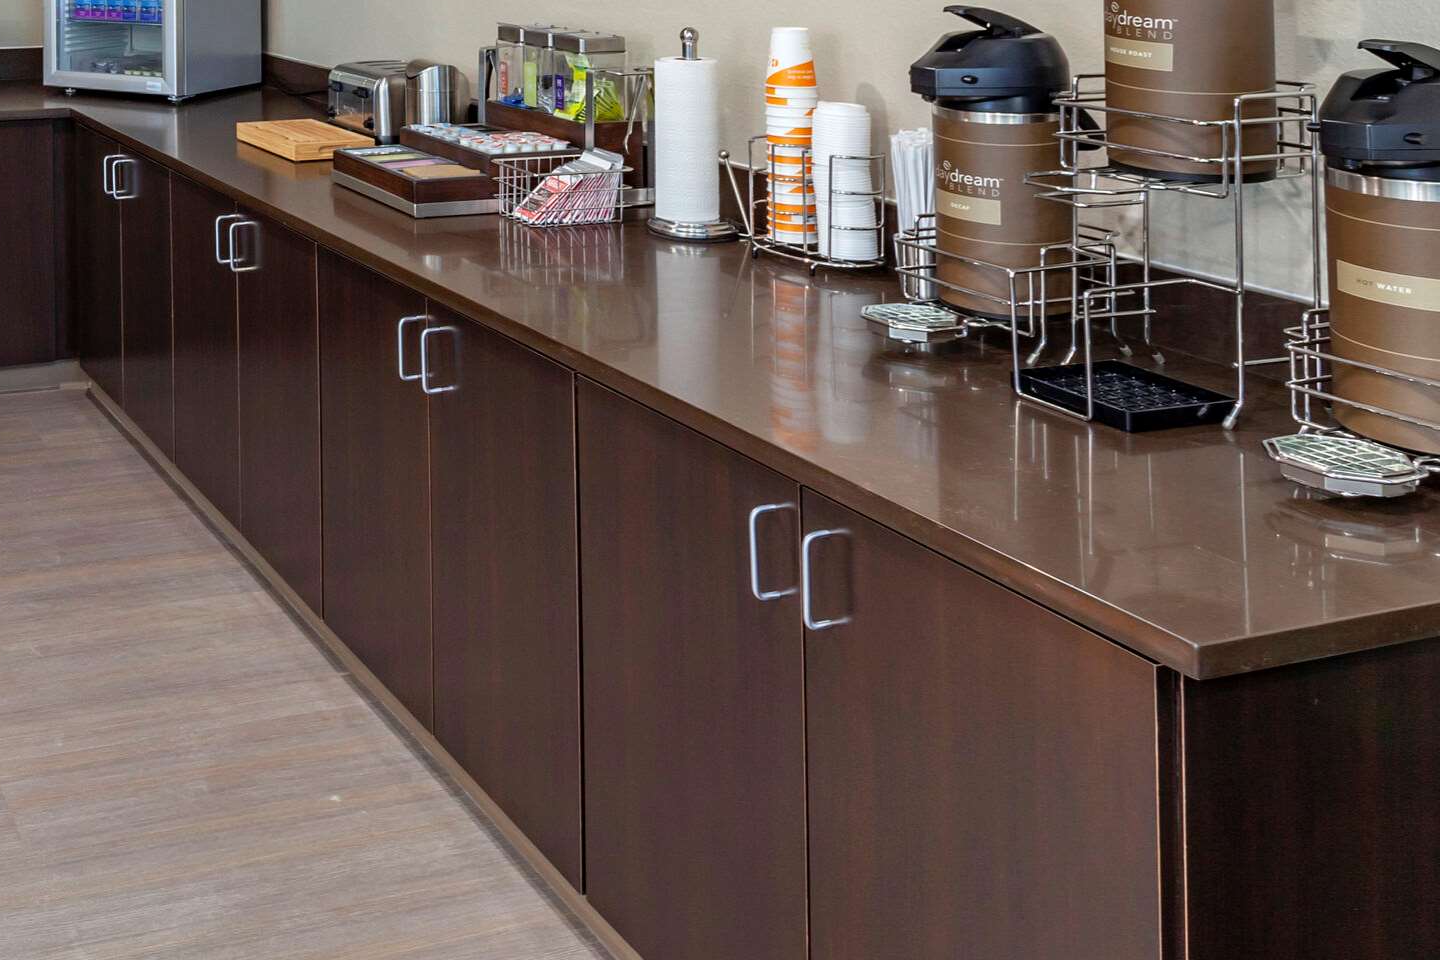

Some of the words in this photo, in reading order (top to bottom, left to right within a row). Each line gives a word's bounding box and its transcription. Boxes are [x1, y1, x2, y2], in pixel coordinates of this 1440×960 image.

[1117, 25, 1173, 40] BLEND
[949, 182, 1000, 197] BLEND
[1376, 282, 1412, 294] WATER
